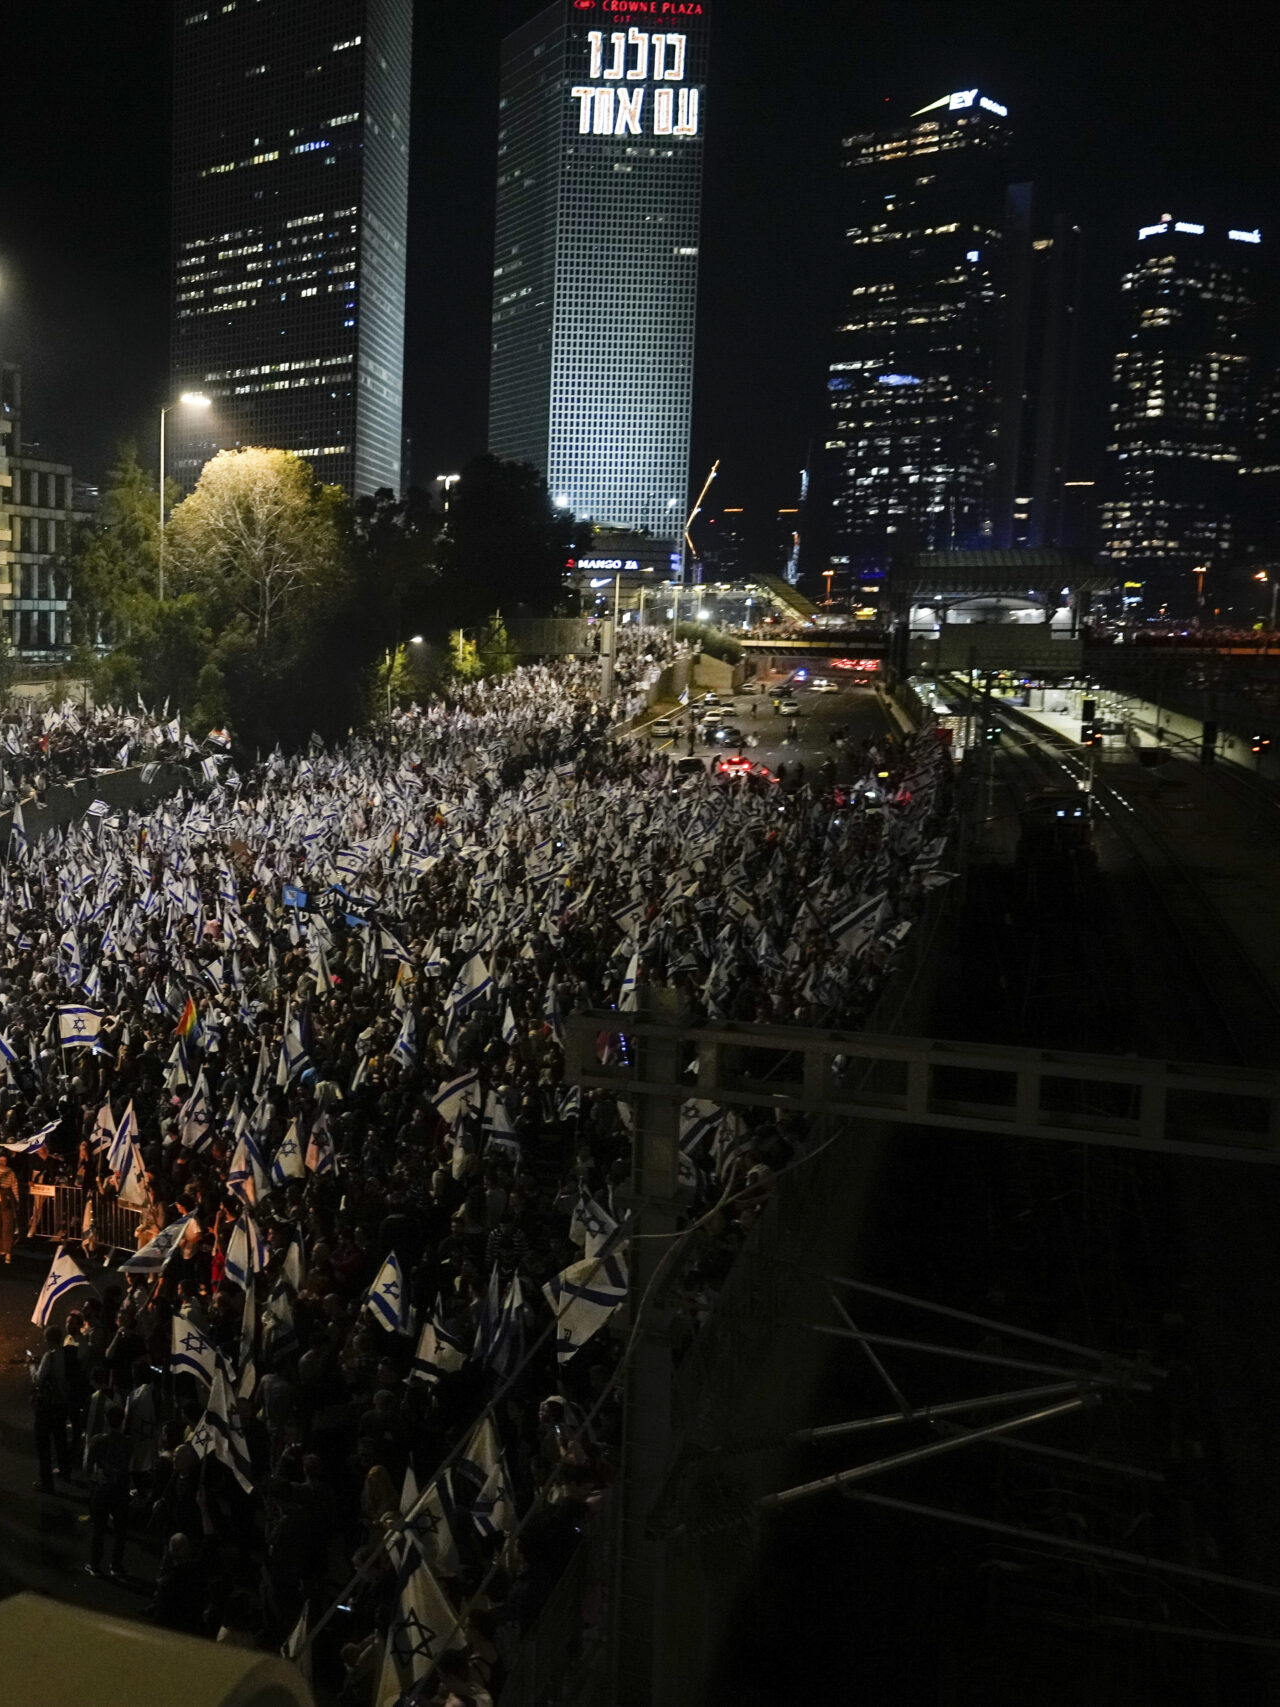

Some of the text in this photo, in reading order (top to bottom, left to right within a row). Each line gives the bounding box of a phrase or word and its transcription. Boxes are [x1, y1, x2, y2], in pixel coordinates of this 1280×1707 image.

[602, 0, 703, 14] CROWNE PLAZA
[588, 27, 686, 80] כולנו
[571, 86, 699, 135] עם אחד
[578, 560, 621, 569] MANGO
